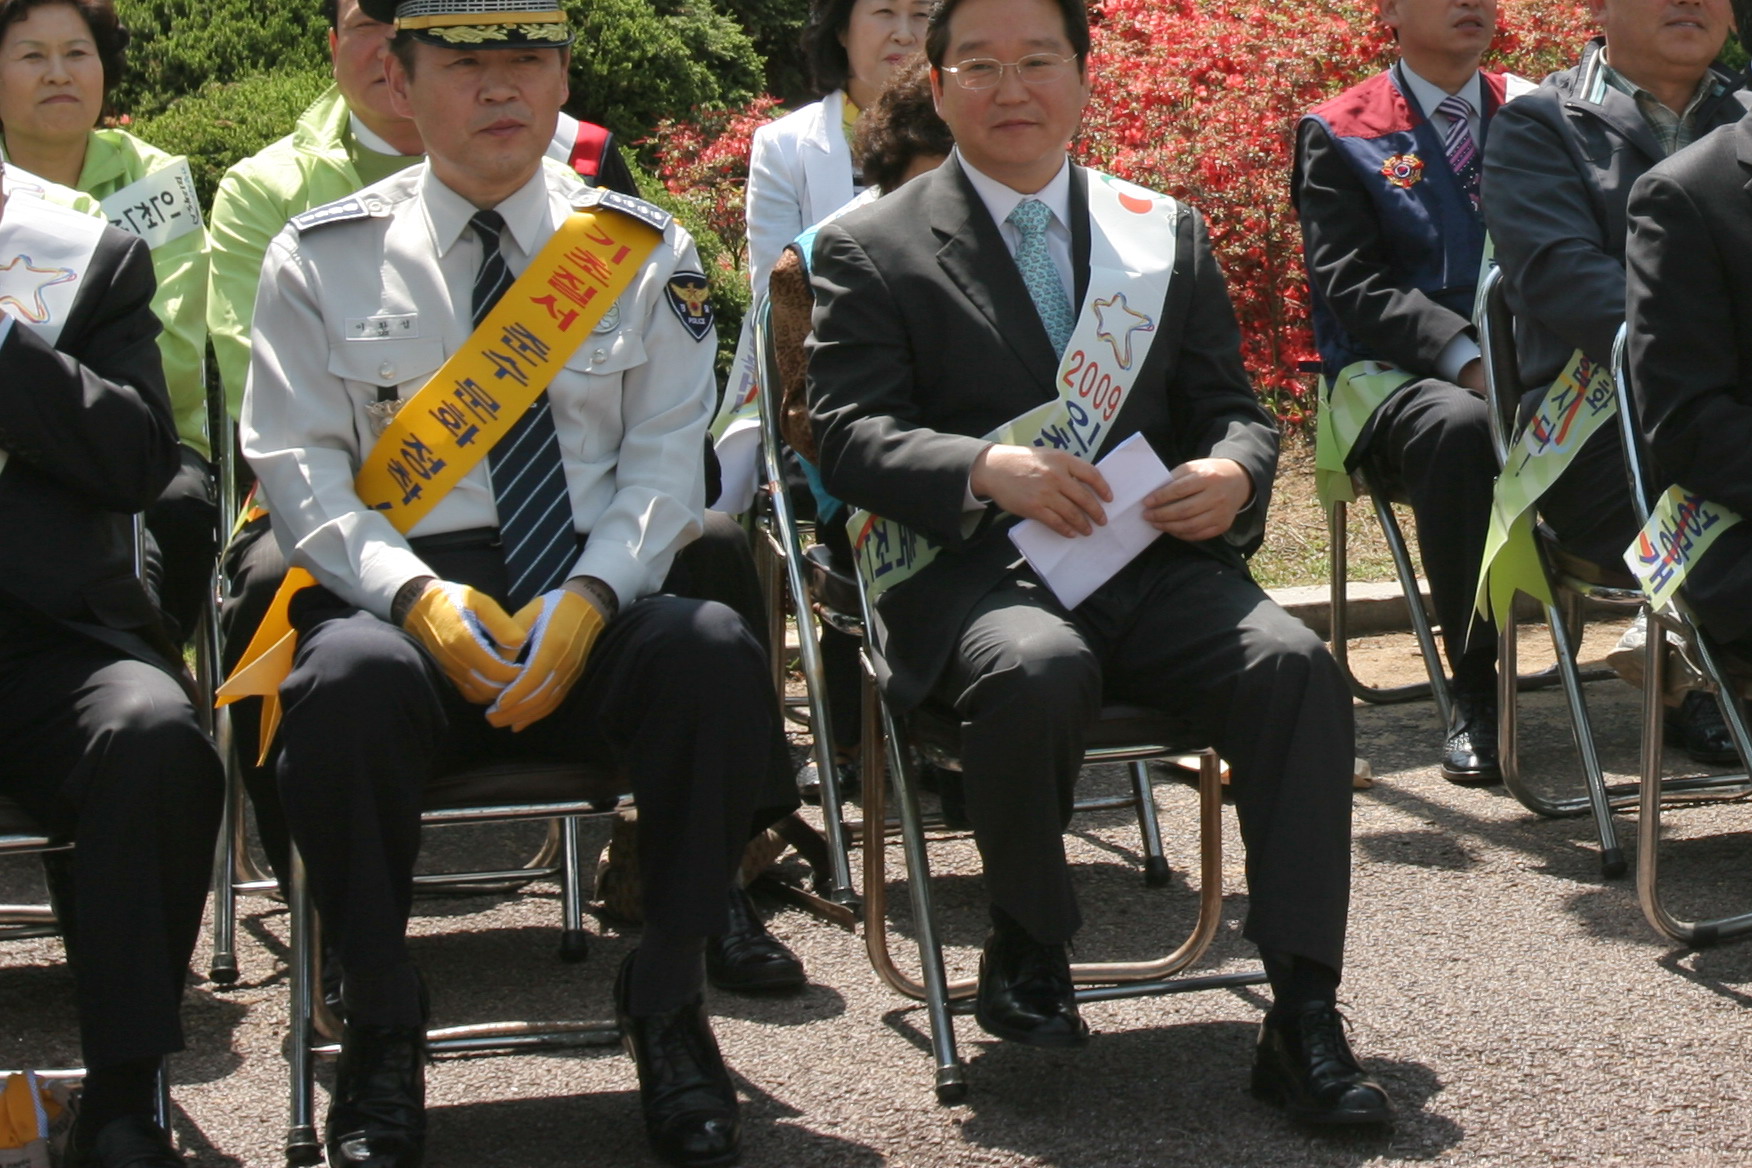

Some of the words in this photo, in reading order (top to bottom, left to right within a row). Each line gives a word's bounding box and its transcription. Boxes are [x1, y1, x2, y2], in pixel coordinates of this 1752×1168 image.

[529, 224, 632, 332] 기초질서
[481, 321, 551, 387] 준수
[1062, 349, 1122, 422] 2009
[428, 377, 501, 448] 문화
